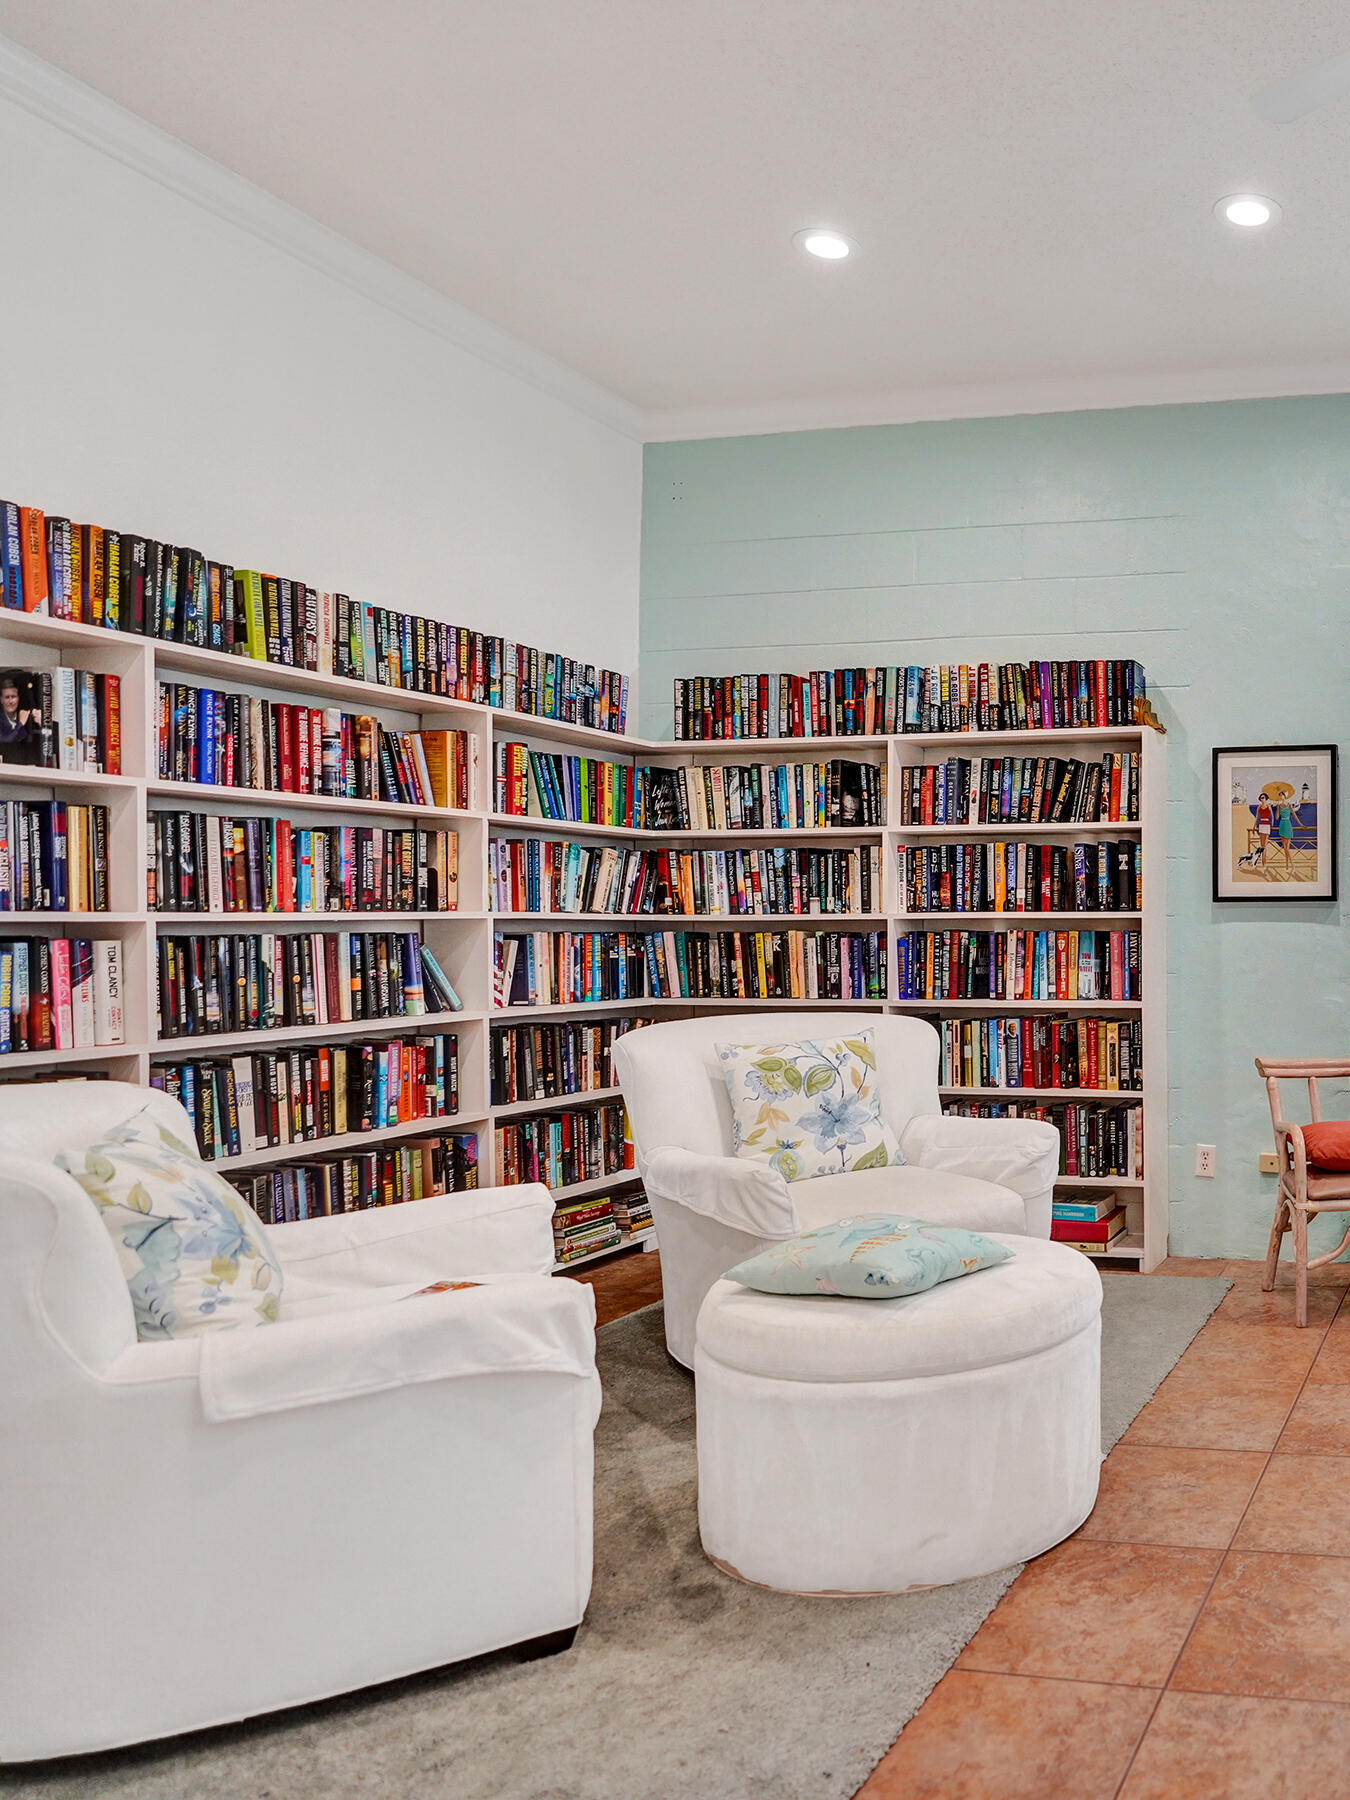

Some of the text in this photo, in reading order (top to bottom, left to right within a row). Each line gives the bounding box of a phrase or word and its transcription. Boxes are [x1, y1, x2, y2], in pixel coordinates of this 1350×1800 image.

[6, 504, 18, 535] HARLAN
[8, 537, 20, 566] COBEN
[109, 544, 119, 576] HARLAN
[306, 593, 317, 637] AUTOPSY
[62, 671, 75, 736] DAVID BALDACCI
[109, 687, 119, 709] DAVID
[107, 946, 118, 999] TOM CLANCY
[0, 955, 12, 1042] ROBIN COOK CRITICAL
